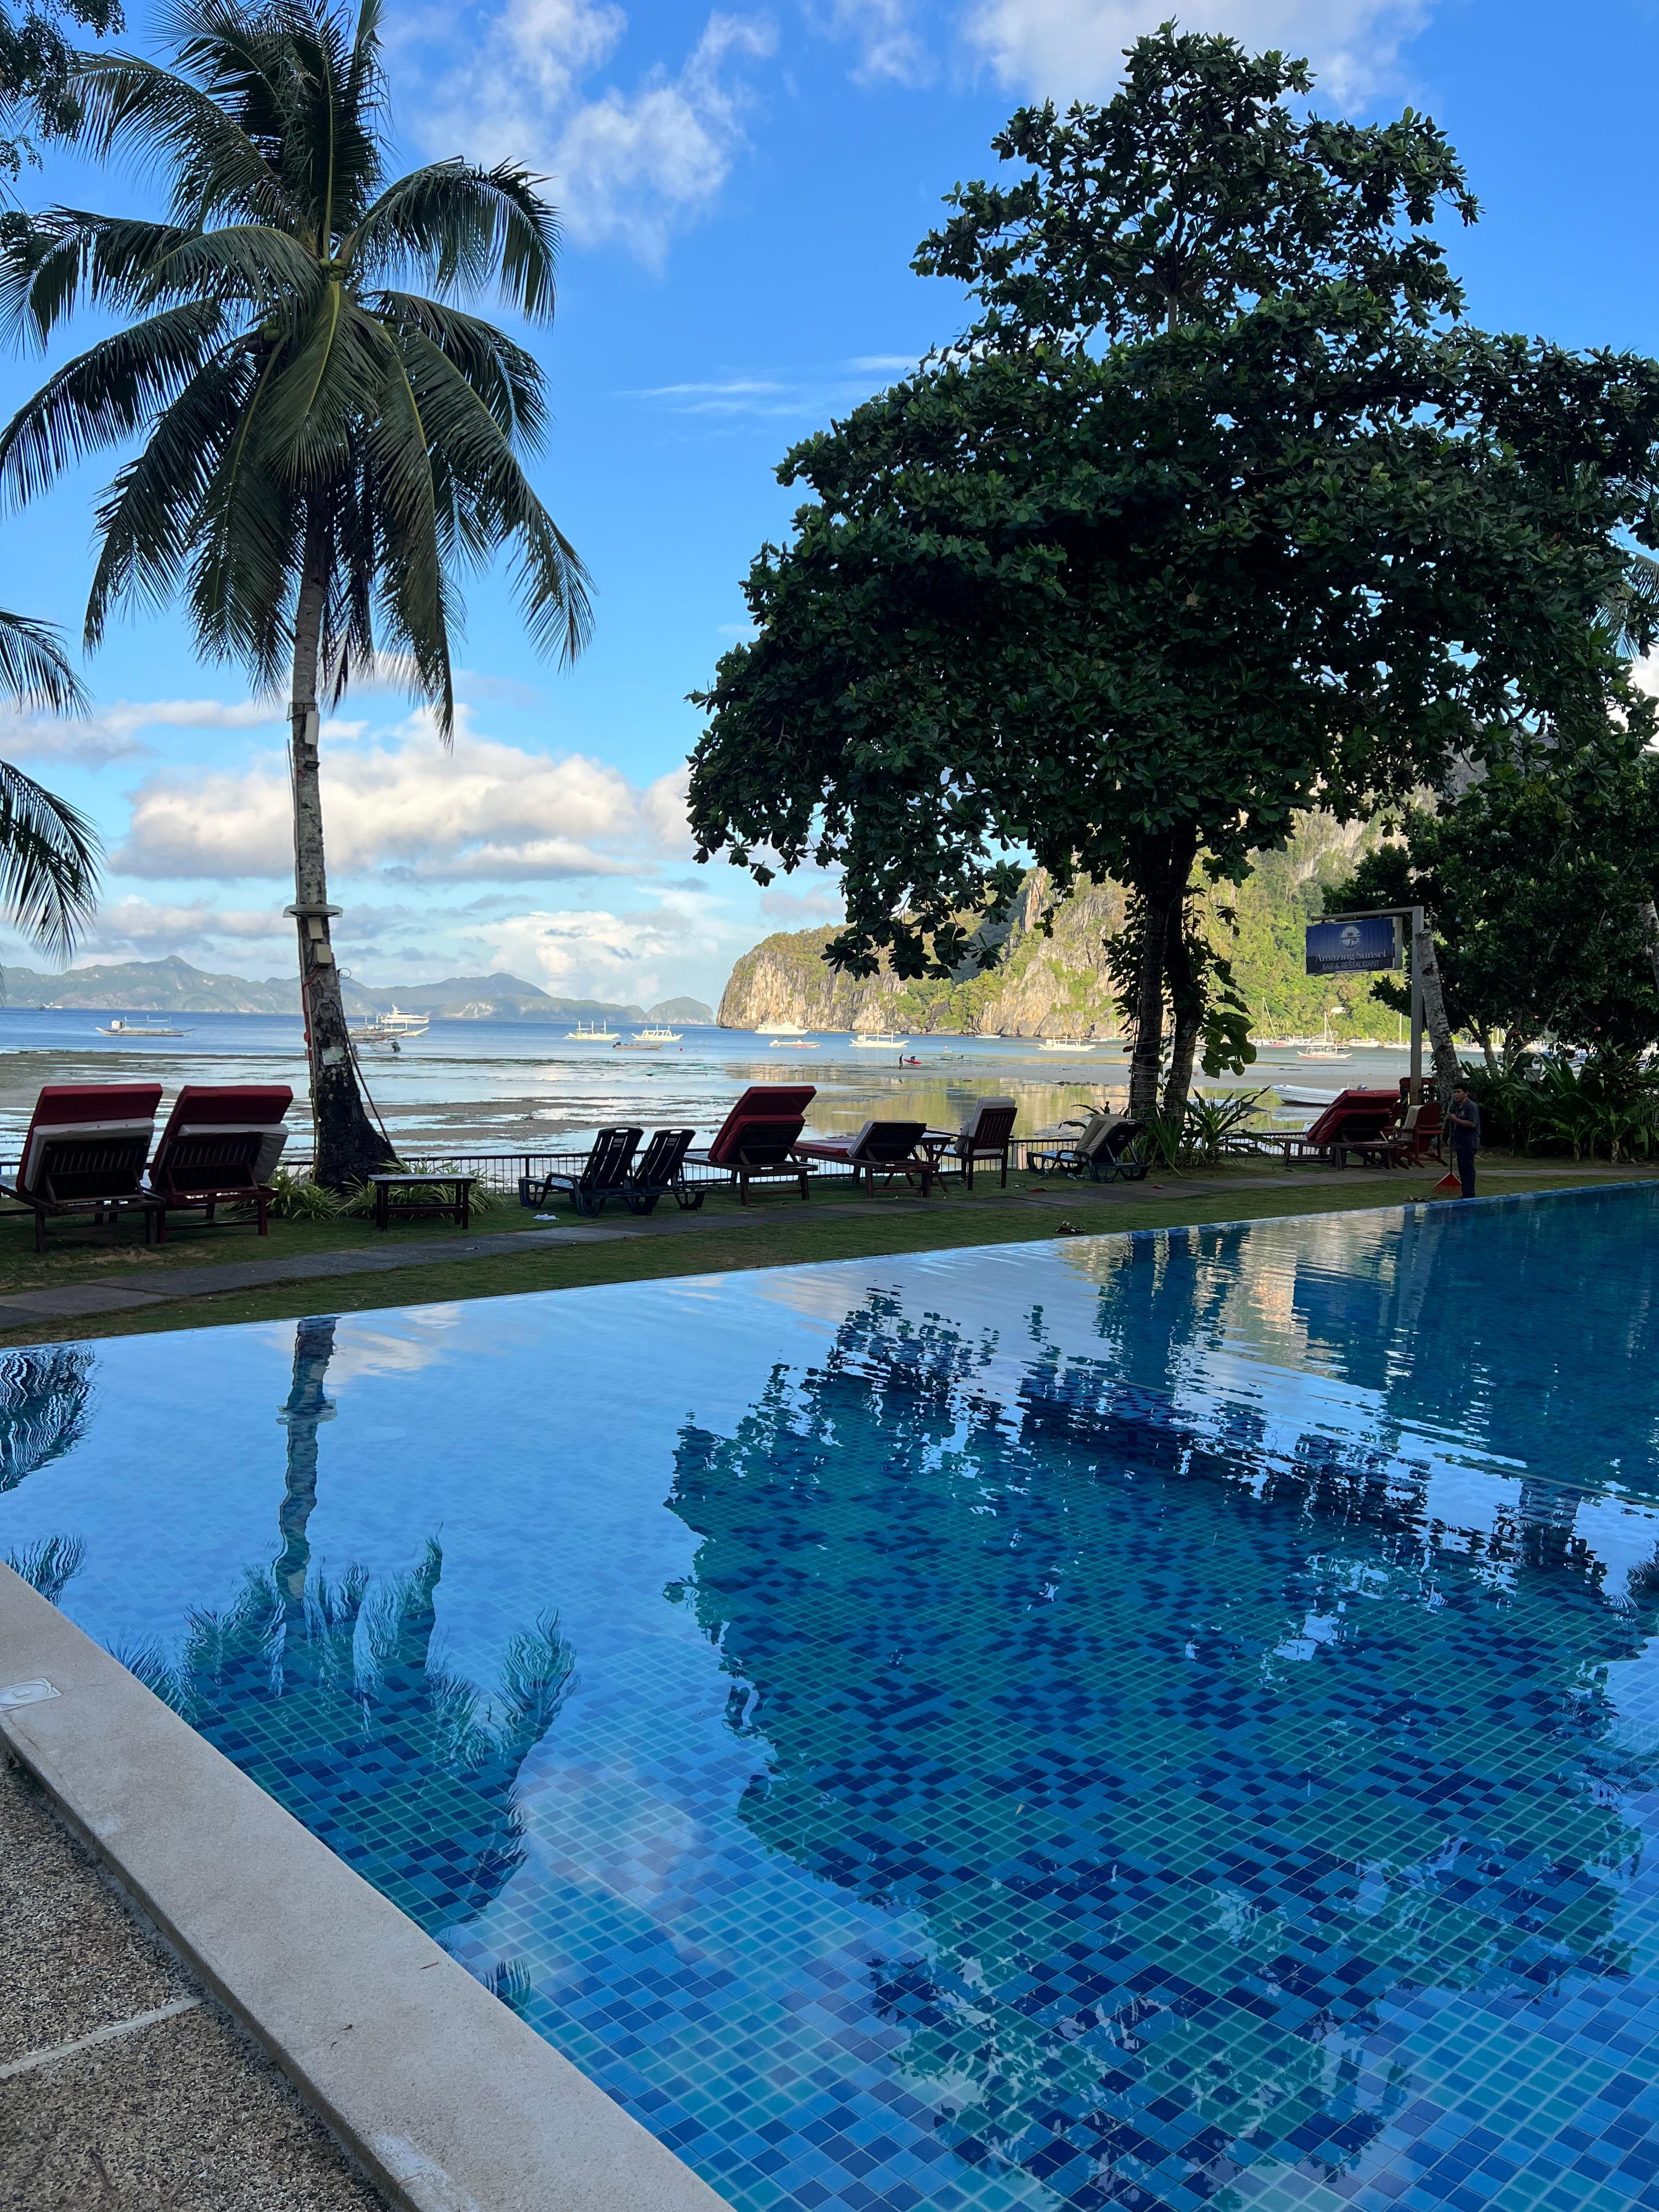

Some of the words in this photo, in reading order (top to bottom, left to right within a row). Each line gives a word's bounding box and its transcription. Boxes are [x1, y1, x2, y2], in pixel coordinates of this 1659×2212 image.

[1316, 953, 1355, 962] Amazing
[1356, 950, 1386, 959] Sunset
[1341, 960, 1379, 968] RESTAURANT
